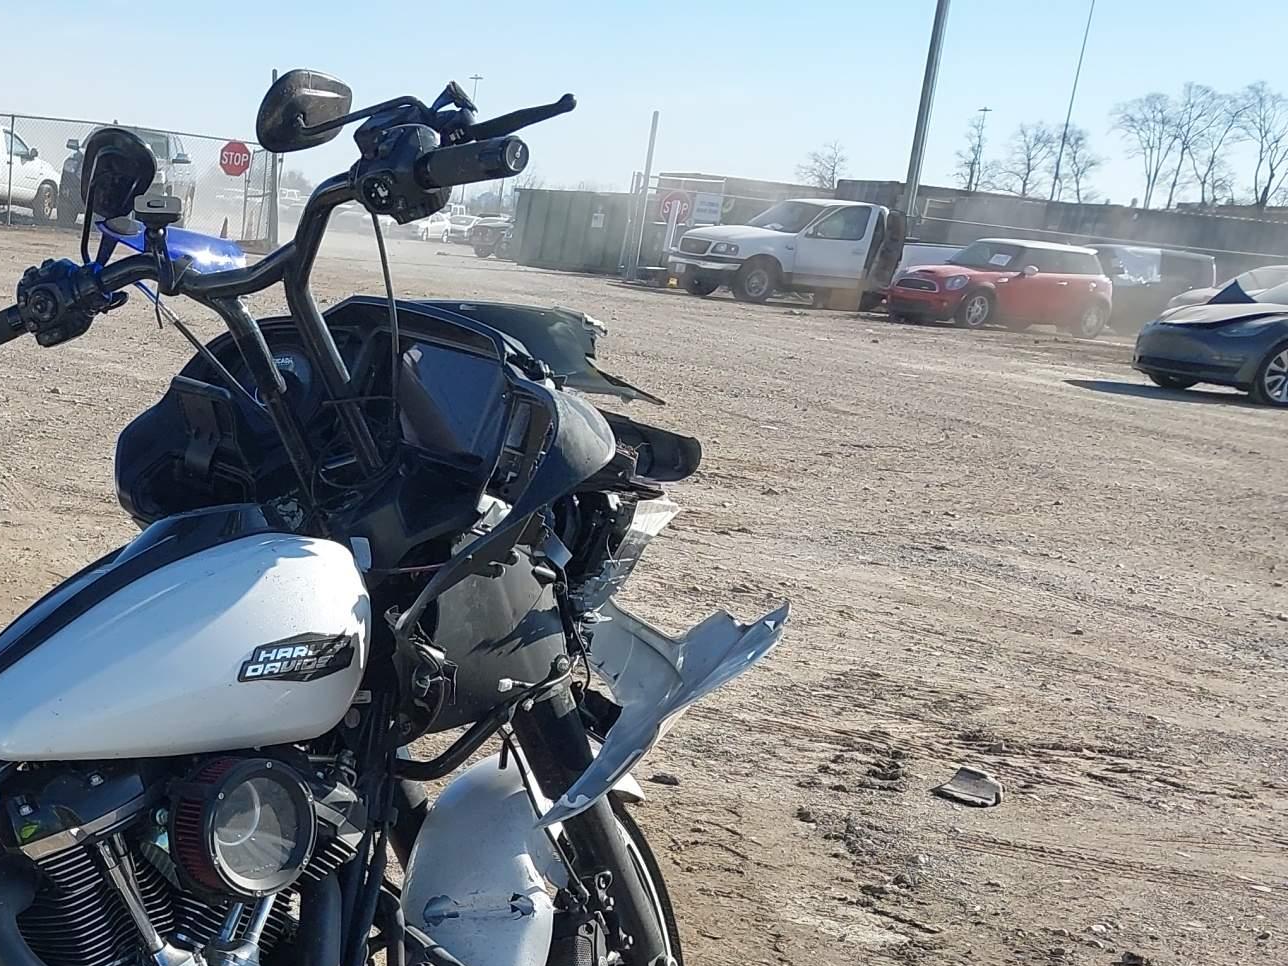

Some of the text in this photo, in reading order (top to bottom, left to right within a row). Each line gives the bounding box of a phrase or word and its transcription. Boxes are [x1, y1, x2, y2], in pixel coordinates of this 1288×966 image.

[222, 151, 249, 166] STOP
[663, 201, 689, 214] SP
[245, 654, 334, 677] DAVIDS
